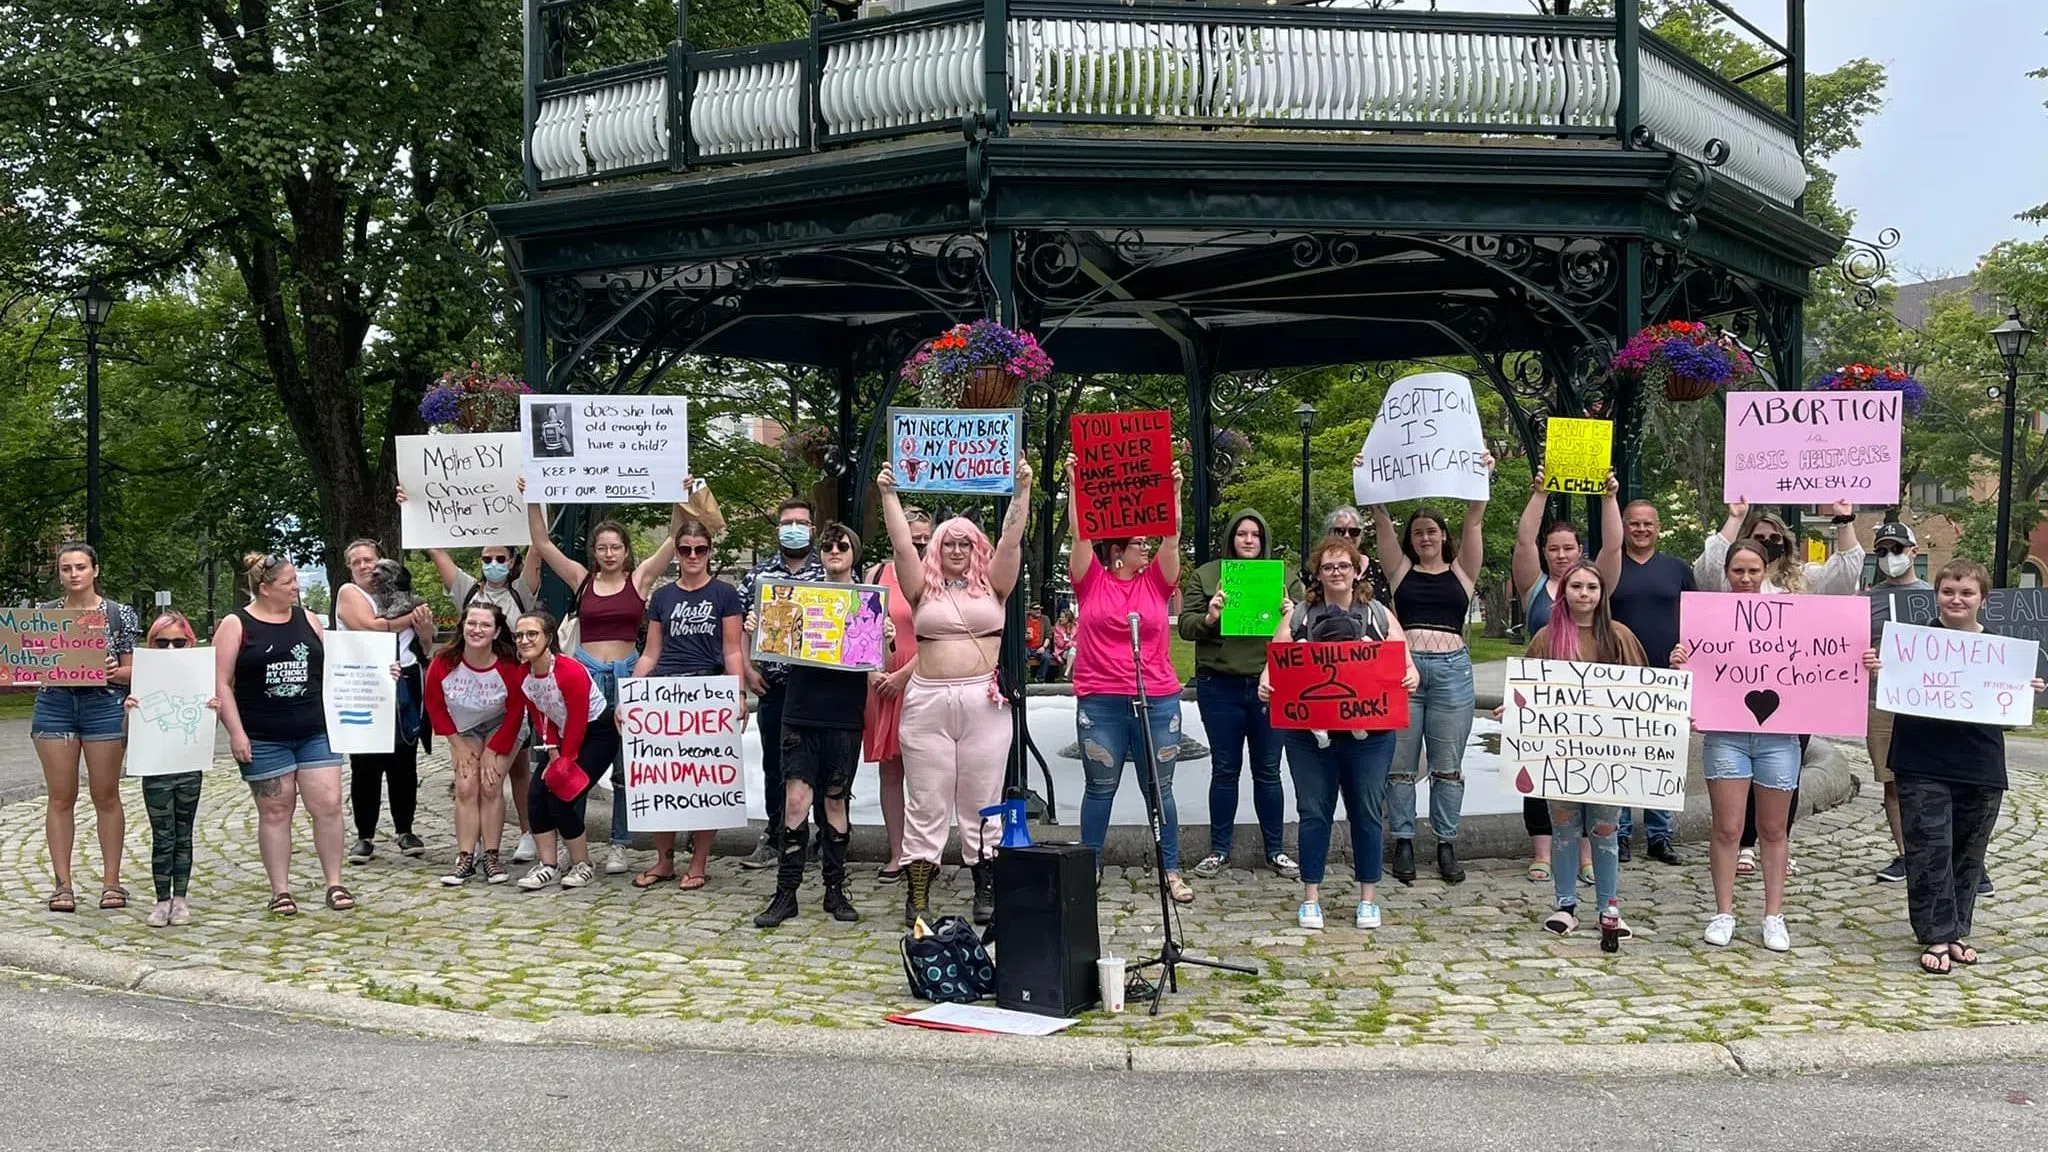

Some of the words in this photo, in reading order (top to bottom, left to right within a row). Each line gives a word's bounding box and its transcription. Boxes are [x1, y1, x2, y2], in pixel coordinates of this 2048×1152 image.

[583, 402, 619, 417] does
[622, 401, 644, 417] she
[651, 404, 674, 417] look
[1377, 387, 1471, 424] ABORTION
[1738, 396, 1897, 427] ABORTION
[585, 421, 606, 432] old
[611, 420, 651, 437] enough
[655, 421, 667, 432] to
[897, 418, 916, 436] MY
[919, 418, 957, 438] NECK,
[958, 419, 976, 437] MY
[977, 419, 1009, 436] BACK
[1079, 418, 1111, 441] YOU
[1120, 416, 1164, 434] WILL
[1401, 419, 1438, 446] IS
[588, 438, 614, 450] have
[619, 441, 626, 450] a
[631, 439, 668, 451] child?
[924, 440, 944, 456] MY
[948, 438, 998, 456] PUSSY
[1084, 439, 1152, 463] NEVER
[424, 447, 473, 481] Mother
[474, 444, 503, 468] BY
[930, 460, 954, 479] MY
[954, 458, 1010, 479] CHOICE
[1371, 448, 1485, 482] HEALTHCARE
[1735, 450, 1789, 471] BASIC
[1799, 444, 1891, 470] HEALTHCARE
[542, 467, 577, 477] KEEP
[582, 466, 610, 477] YOUR
[617, 466, 649, 476] LAWS
[1080, 464, 1117, 480] HAVE
[1121, 458, 1152, 475] THE
[425, 482, 499, 499] Choice
[544, 485, 570, 497] OFF
[575, 485, 597, 497] OUR
[605, 481, 656, 497] BODIES!
[1083, 473, 1163, 496] COMFORT
[1546, 476, 1560, 490] A
[482, 495, 522, 516] FOR
[1092, 496, 1113, 510] OF
[1119, 492, 1144, 508] MY
[1084, 502, 1169, 533] SILENCE
[670, 599, 716, 622] Nasty
[1735, 600, 1793, 633] NOT
[1908, 589, 2048, 622] REAL
[0, 609, 72, 633] Mother
[670, 622, 717, 637] Woman
[21, 634, 46, 655] by
[50, 634, 104, 649] choice
[1895, 634, 2006, 665] WOMEN
[266, 661, 308, 670] MOTHER
[1272, 647, 1304, 670] WE
[1310, 646, 1348, 664] WILL
[1350, 644, 1381, 661] NOT
[13, 666, 42, 681] for
[48, 665, 104, 680] choice
[1922, 671, 1965, 685] NOT
[622, 681, 650, 704] I'd
[656, 684, 700, 703] rather
[704, 683, 724, 700] be
[1534, 685, 1594, 706] HAVE
[1885, 687, 1974, 709] WOMBS
[1284, 702, 1310, 721] GO
[1339, 691, 1388, 720] BACK!
[627, 707, 734, 737] SOLDIER
[1519, 706, 1603, 737] PARTS
[679, 740, 721, 759] become
[724, 744, 739, 759] a
[1644, 746, 1675, 760] BAN
[629, 761, 737, 788] HANDMAID
[631, 791, 746, 819] #PROCHOICE
